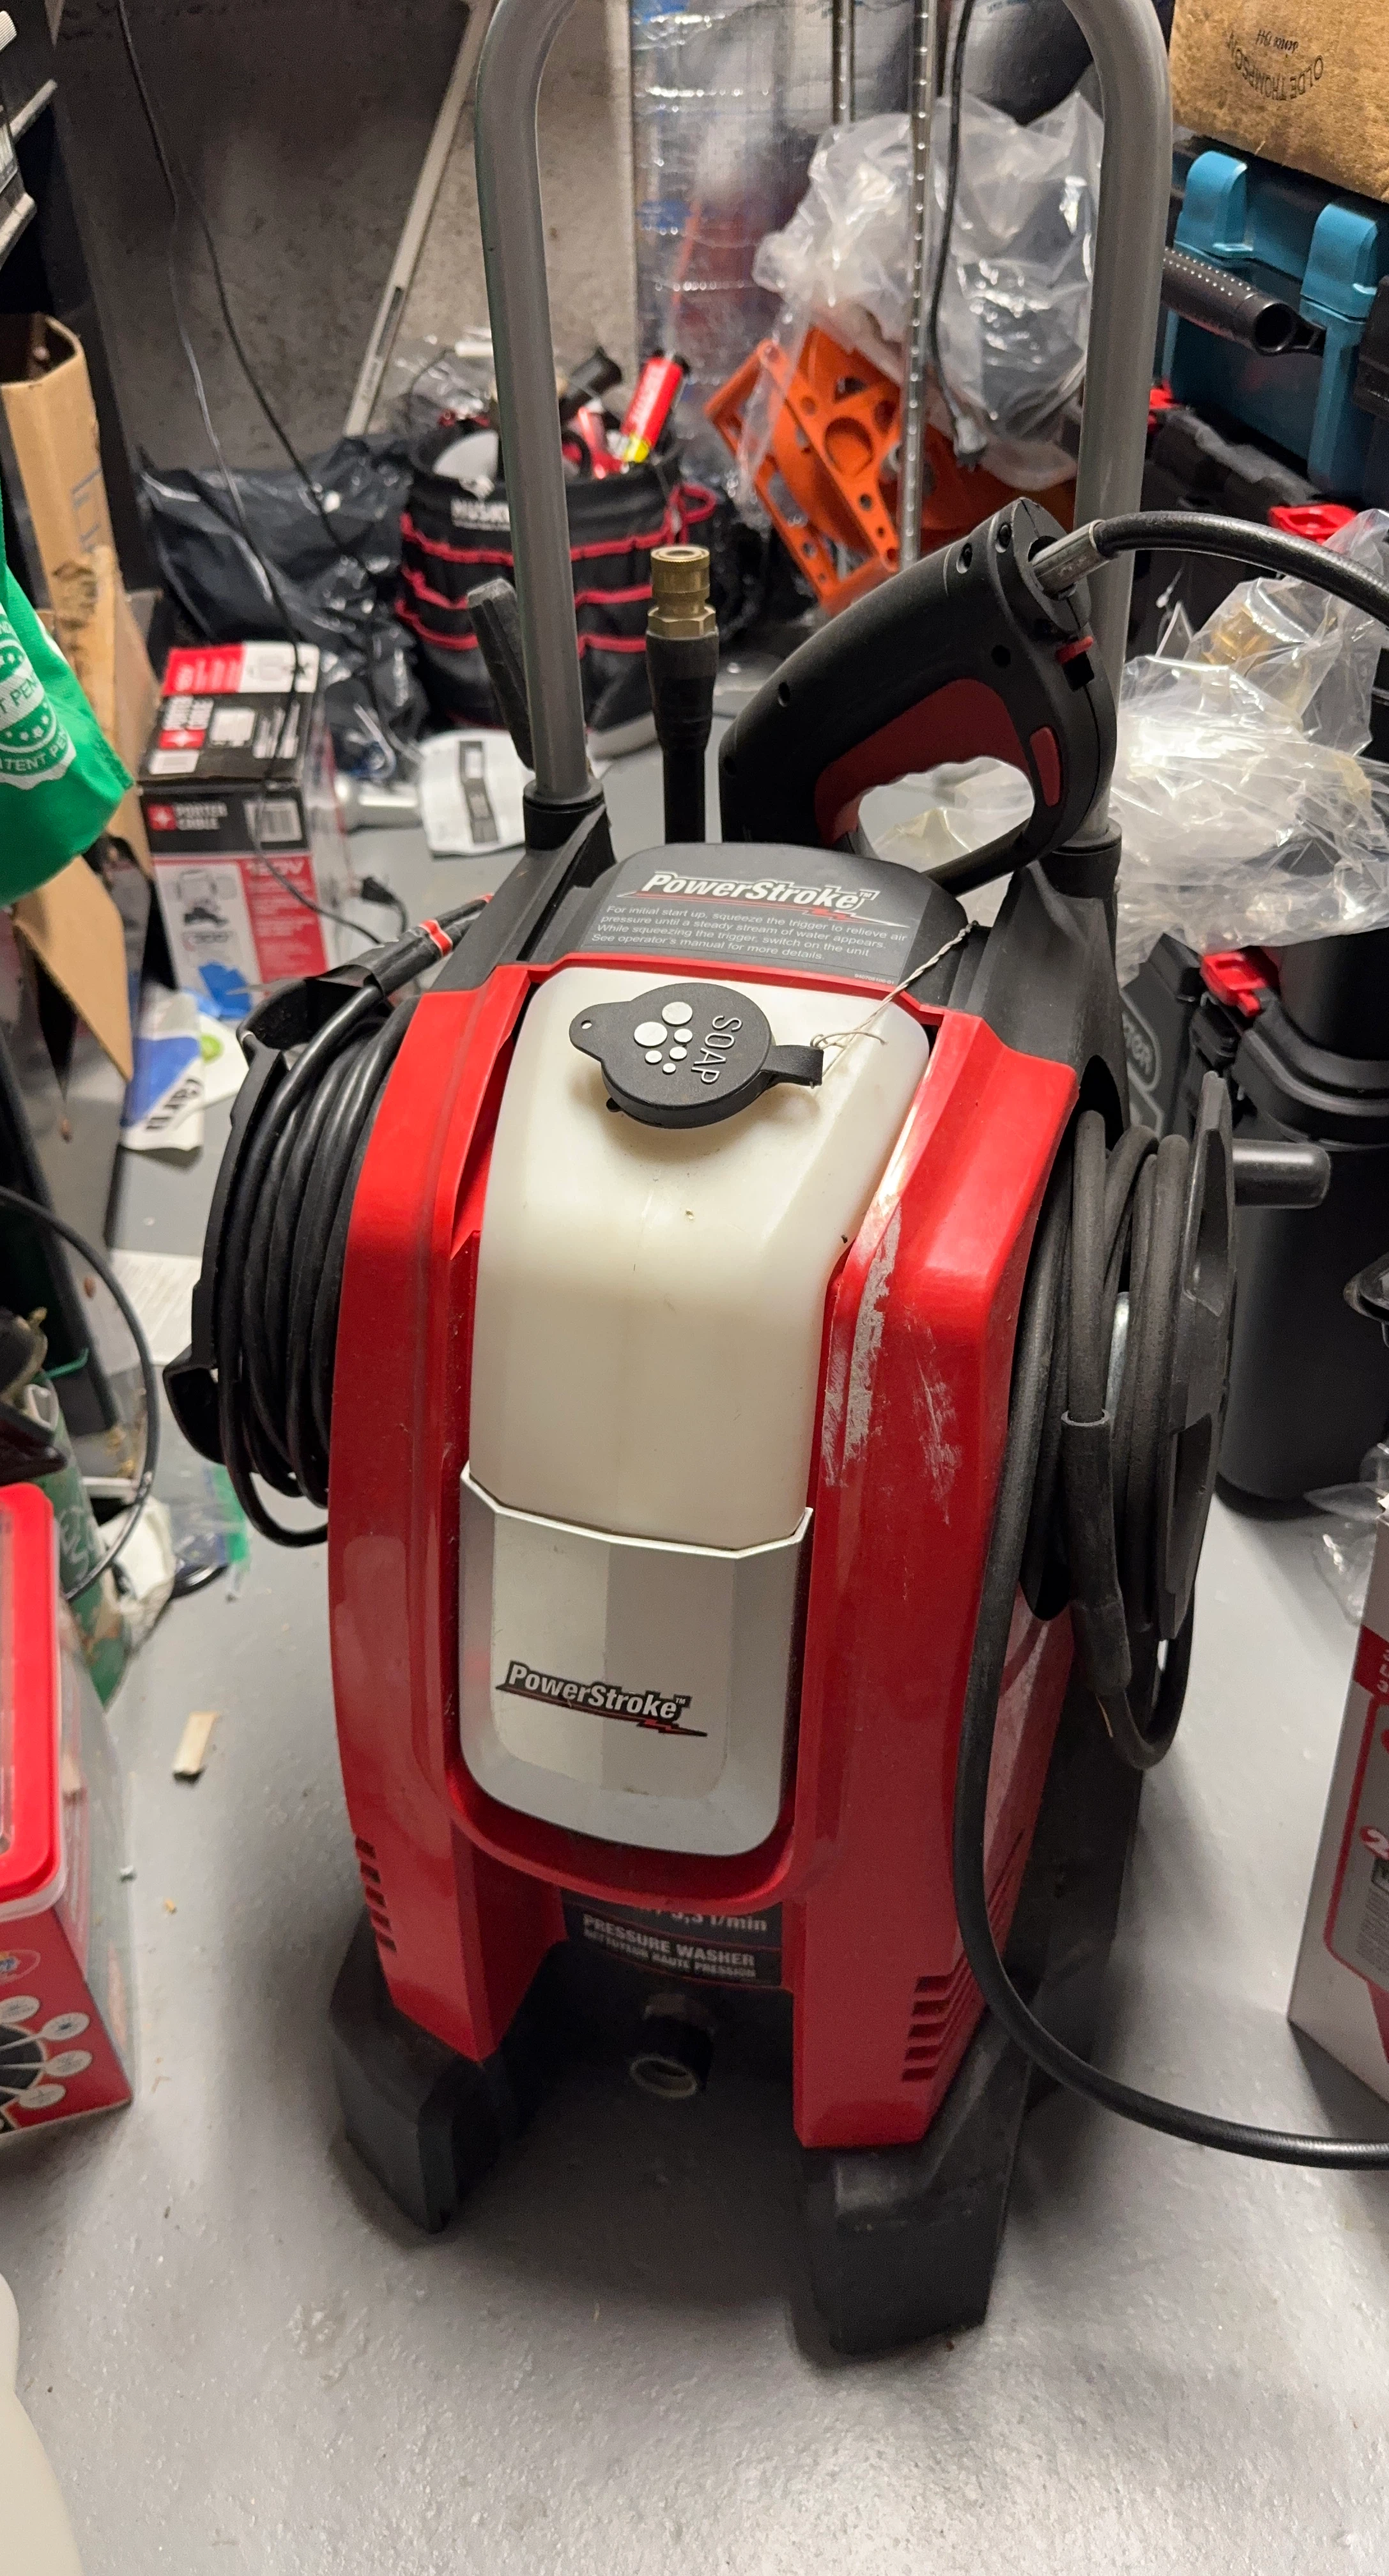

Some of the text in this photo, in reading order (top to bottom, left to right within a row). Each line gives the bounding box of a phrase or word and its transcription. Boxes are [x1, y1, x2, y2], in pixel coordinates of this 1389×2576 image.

[1290, 55, 1323, 99] OLDE
[597, 924, 629, 933] While
[632, 926, 692, 939] squeezing
[696, 930, 715, 939] the
[762, 936, 800, 947] switch
[804, 941, 820, 949] on
[824, 942, 843, 952] the
[846, 946, 870, 957] unit
[600, 915, 652, 924] pressure
[655, 917, 680, 926] until
[694, 919, 734, 931] steady
[736, 924, 778, 934] stream
[781, 927, 794, 936] of
[796, 930, 831, 940] water
[833, 935, 886, 949] appears.
[606, 905, 907, 942] For initial start up, squeeze the trigger to relieve air
[592, 933, 615, 942] See
[680, 939, 725, 949] manual
[728, 942, 745, 951] for
[746, 946, 779, 955] more
[781, 947, 825, 960] details.
[691, 1015, 743, 1084] SOAP
[583, 1913, 755, 1966] PRESSURE WASHER
